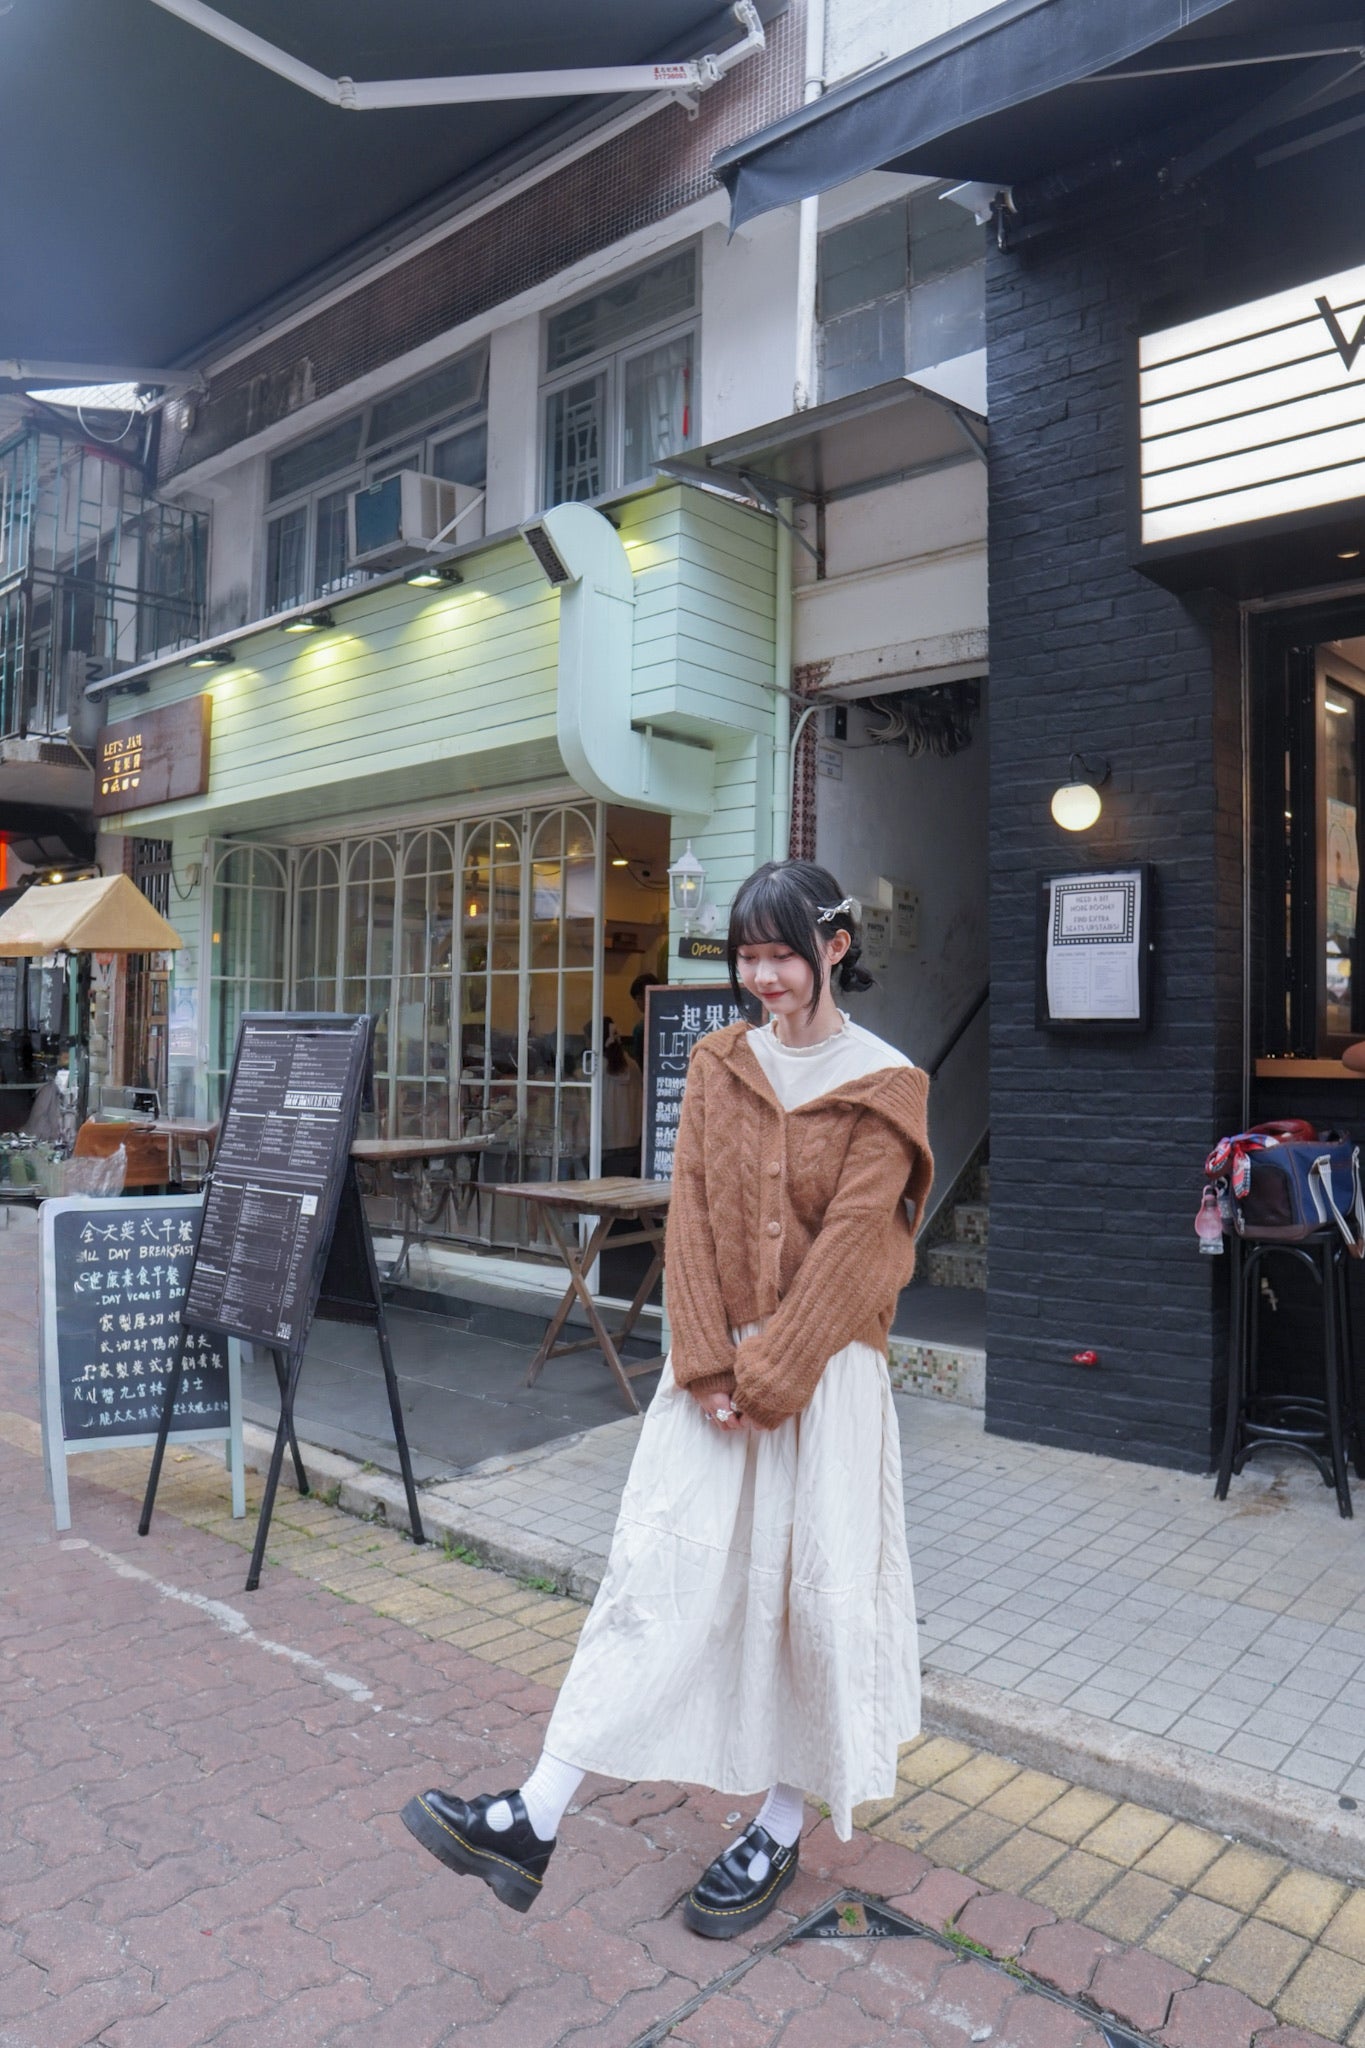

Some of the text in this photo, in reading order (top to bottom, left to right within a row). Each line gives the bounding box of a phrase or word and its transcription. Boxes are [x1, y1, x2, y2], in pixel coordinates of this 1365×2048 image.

[691, 942, 723, 957] Open
[80, 1218, 193, 1243] 全天英式早餐
[108, 1248, 131, 1261] DAY
[140, 1244, 195, 1259] BREAKFAST
[102, 1294, 121, 1305] DAY
